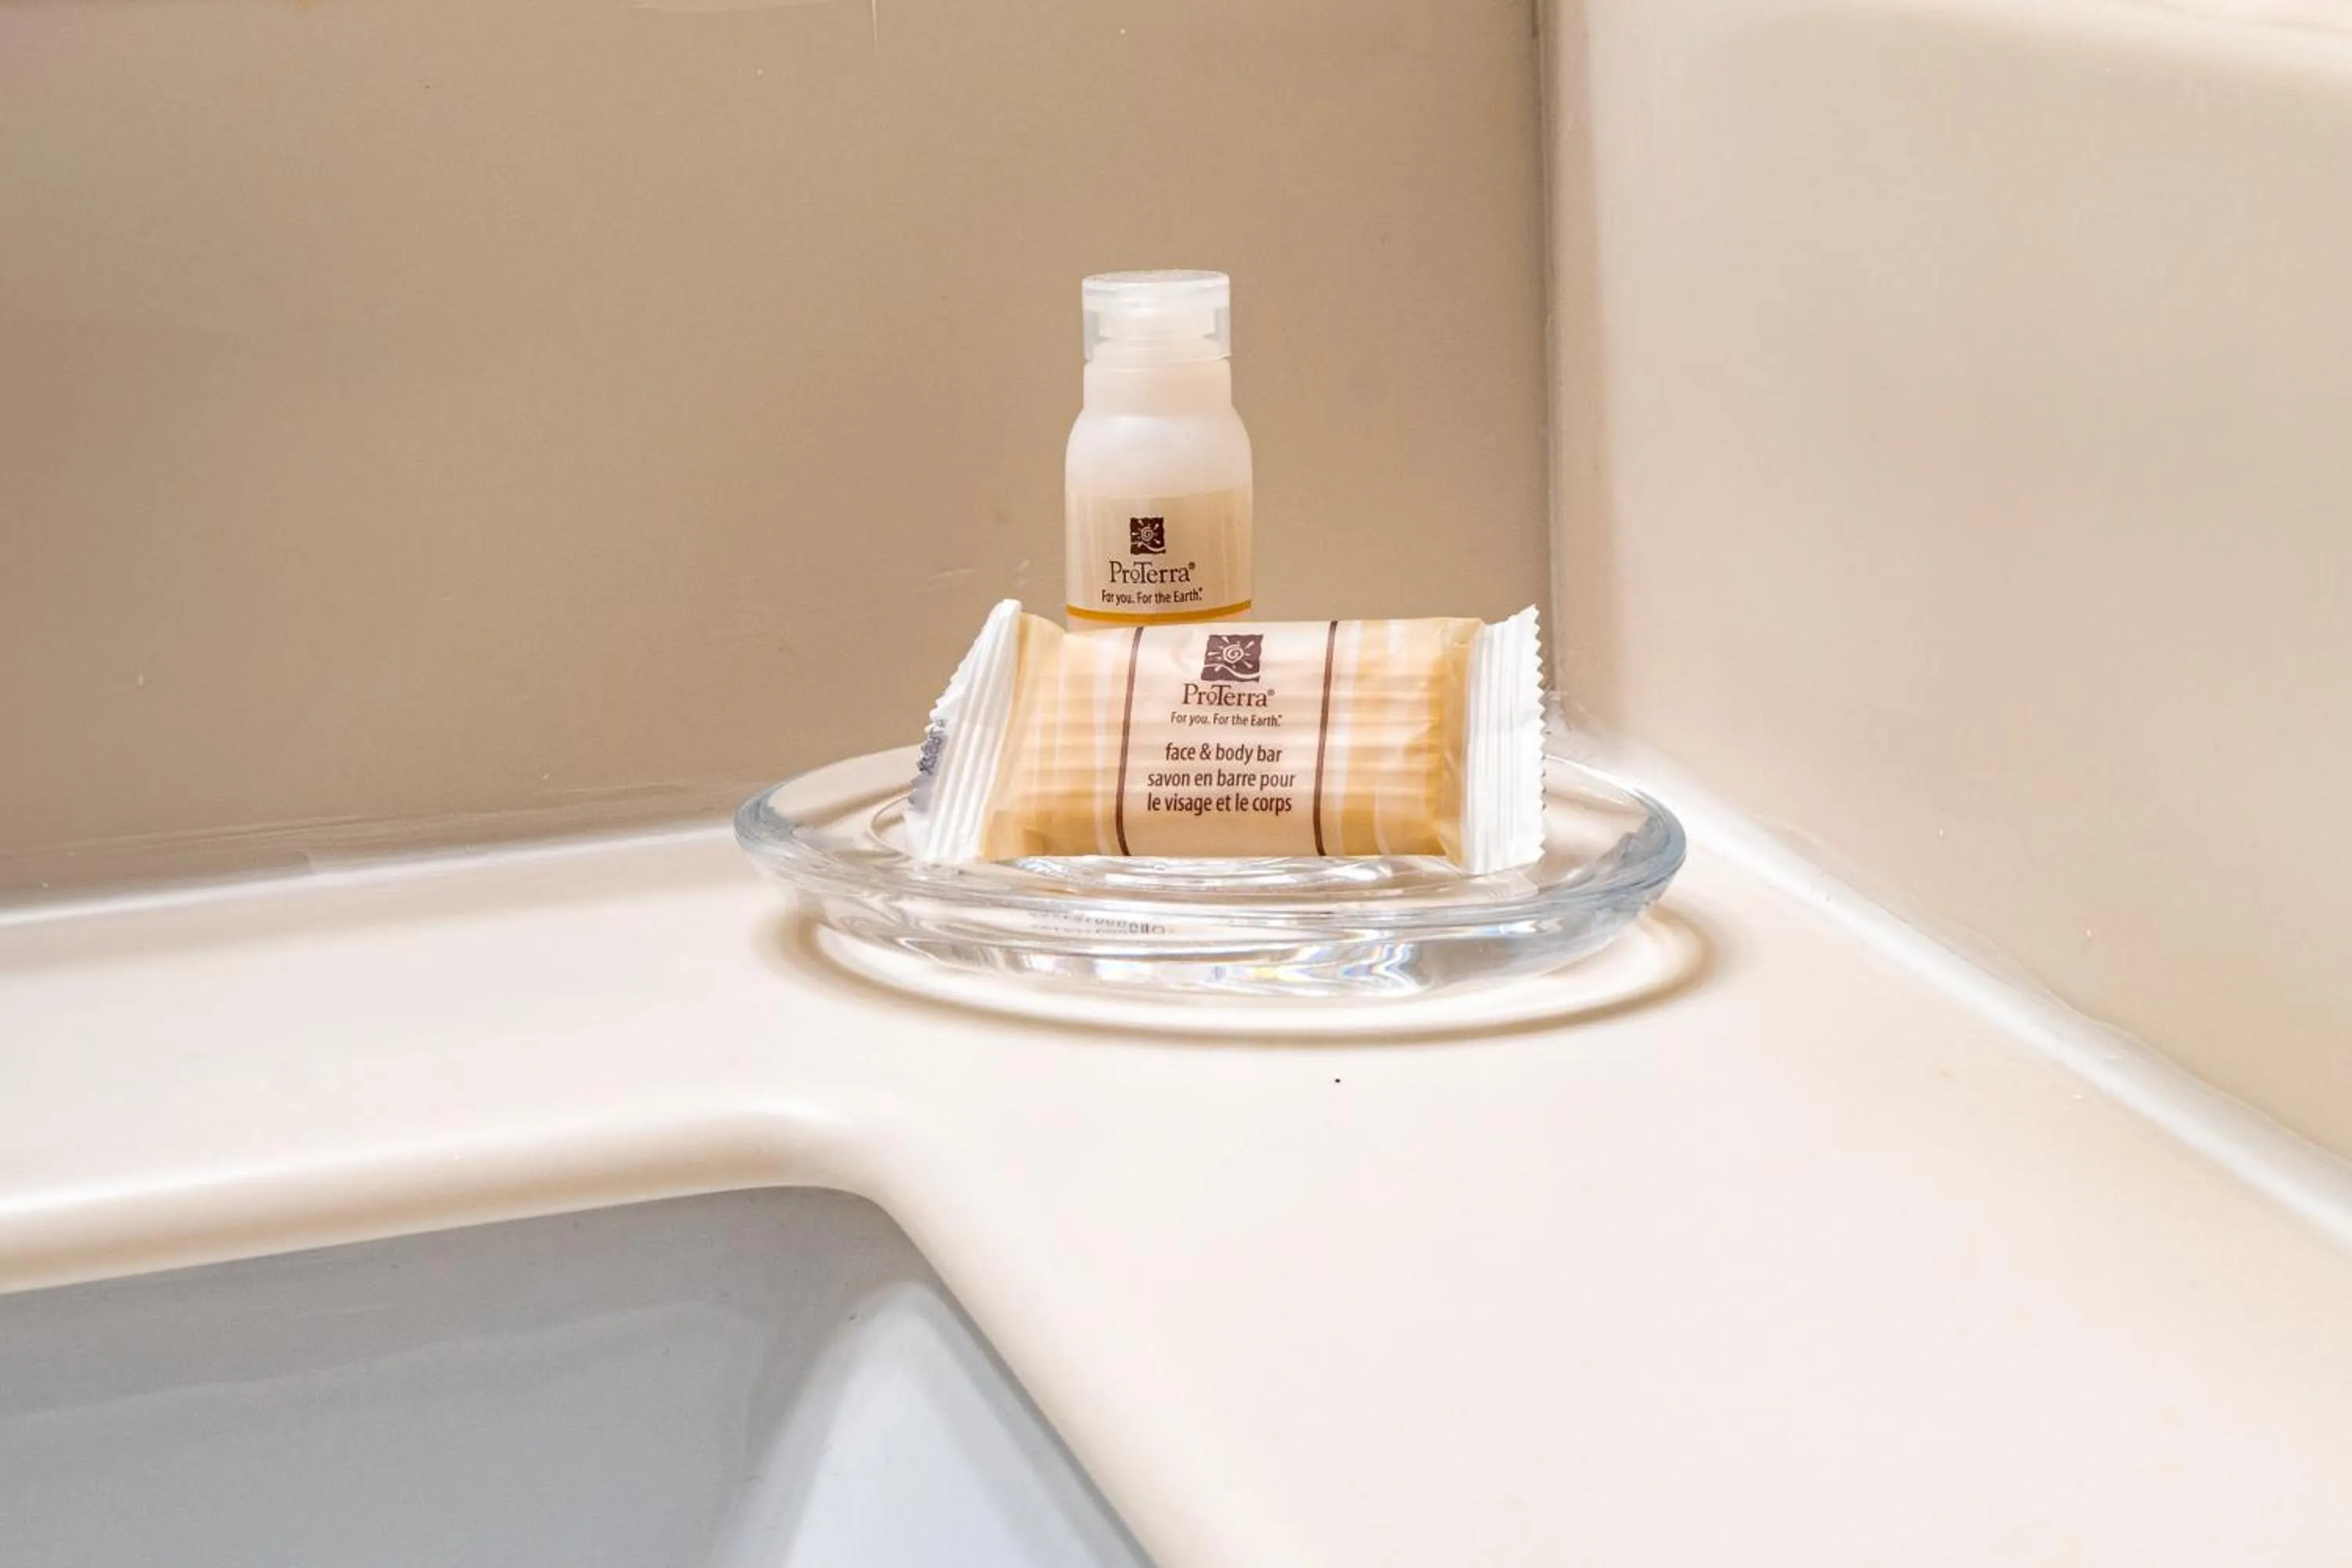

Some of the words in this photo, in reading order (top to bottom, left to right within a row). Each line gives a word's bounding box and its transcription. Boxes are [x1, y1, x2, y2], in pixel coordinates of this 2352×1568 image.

[1102, 589, 1114, 603] For
[1136, 591, 1152, 604] For
[1154, 591, 1172, 604] the
[1171, 711, 1188, 724] For
[1189, 714, 1210, 727] you.
[1212, 713, 1230, 725] For
[1232, 714, 1249, 726] the
[1166, 742, 1196, 760] face
[1199, 743, 1211, 760] &
[1215, 742, 1254, 765] body
[1257, 745, 1283, 763] bar
[1147, 771, 1191, 787] savon
[1194, 772, 1214, 787] en
[1217, 769, 1256, 787] barre
[1260, 773, 1295, 790] pour
[1147, 793, 1161, 811] le
[1164, 793, 1213, 815] visage
[1215, 795, 1232, 812] et
[1235, 793, 1249, 811] le
[1252, 797, 1293, 816] corps
